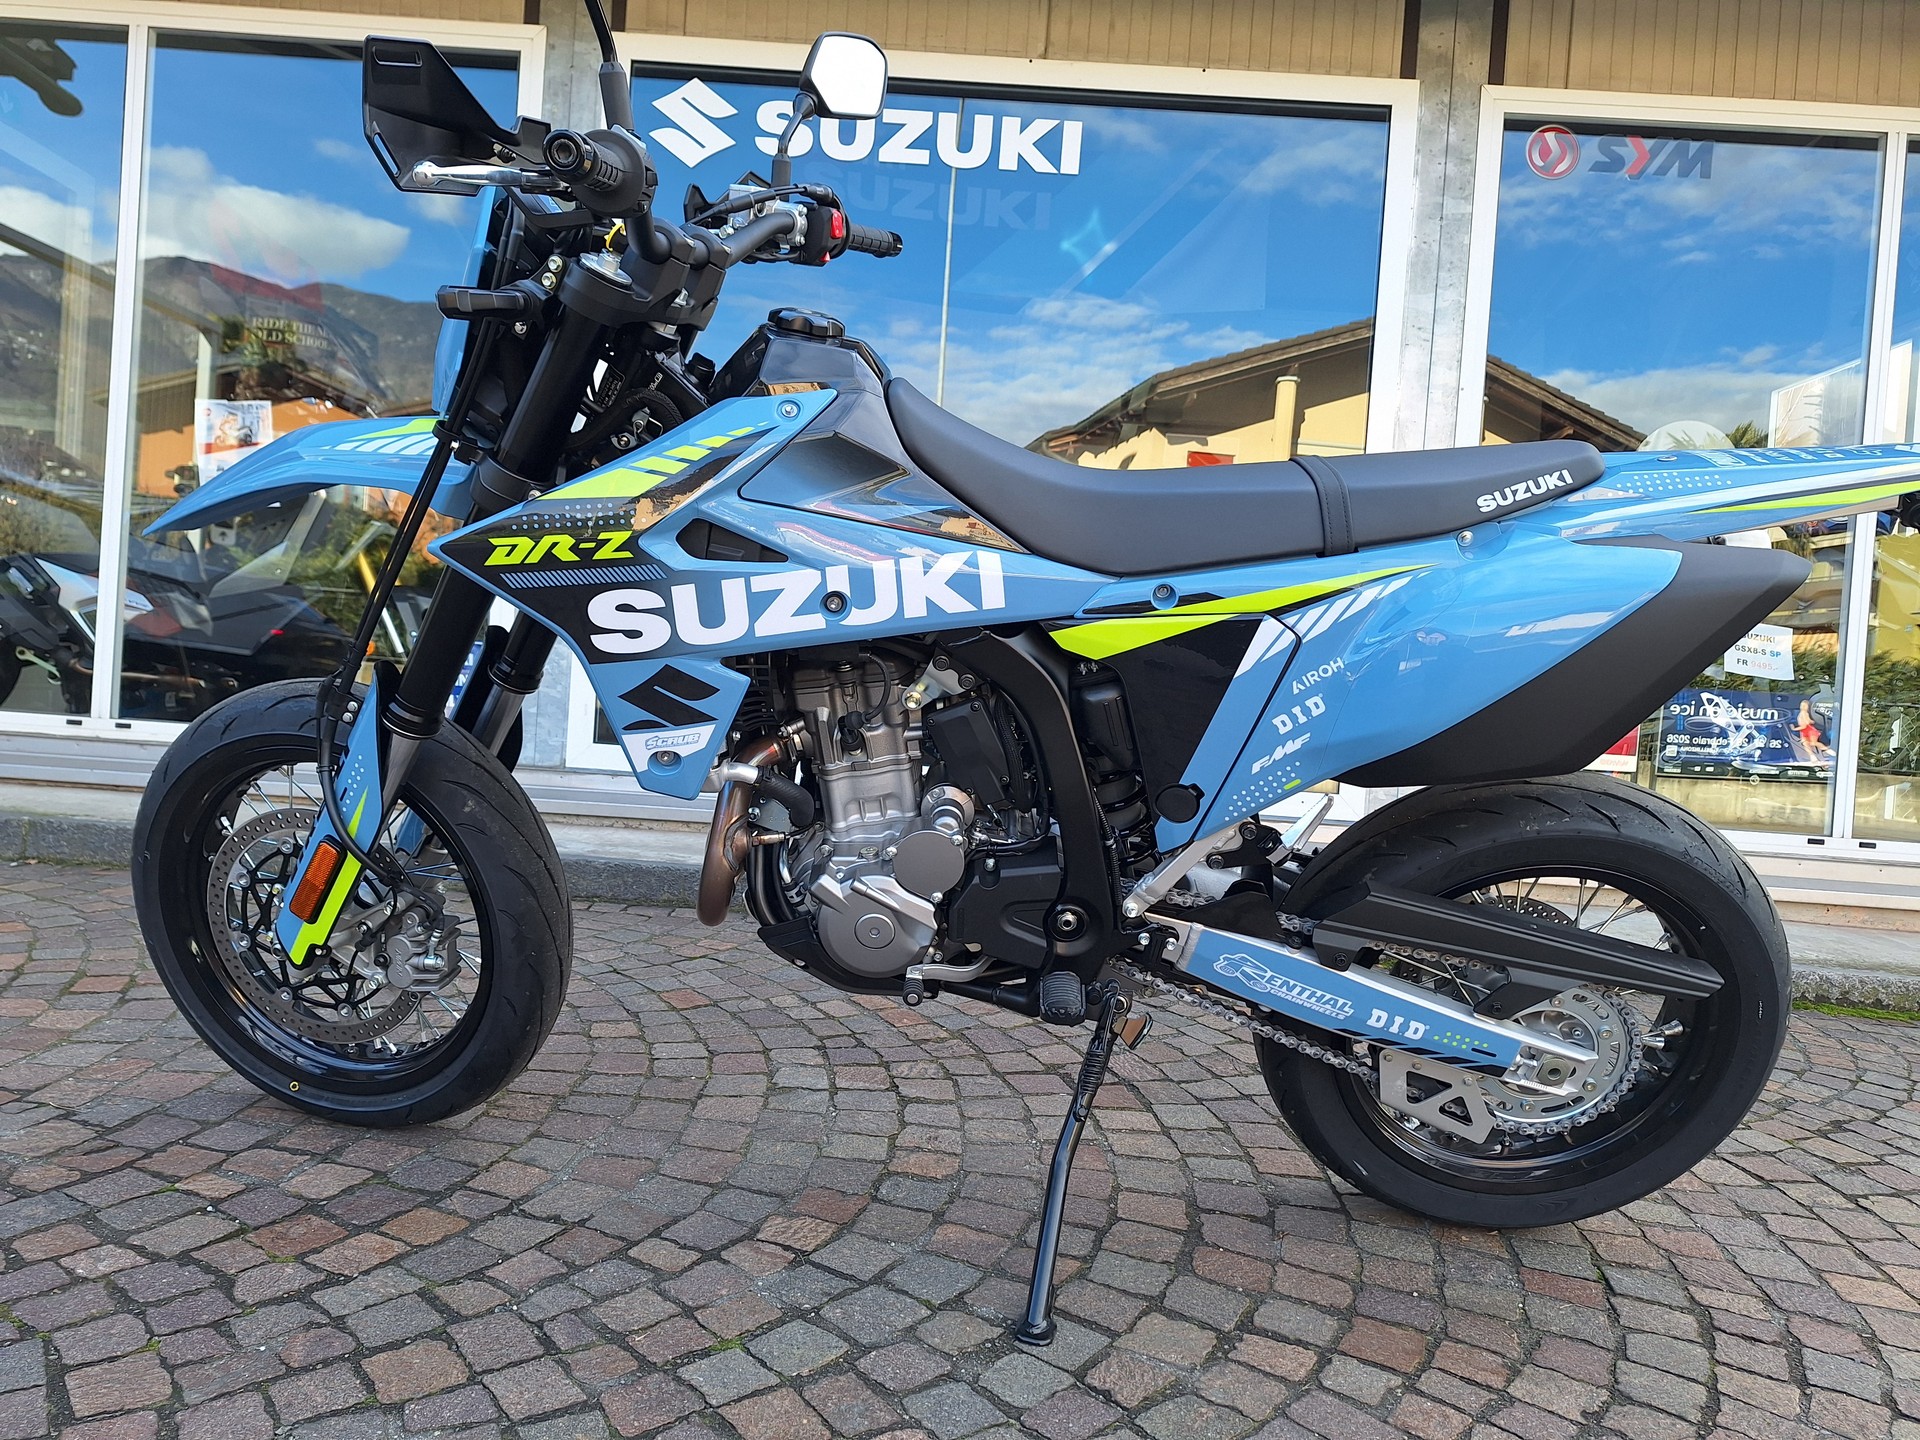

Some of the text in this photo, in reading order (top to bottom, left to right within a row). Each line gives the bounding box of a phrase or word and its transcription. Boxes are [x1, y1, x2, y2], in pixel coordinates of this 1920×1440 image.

[754, 100, 1083, 175] SUZUKI
[1588, 134, 1715, 180] SYM
[1476, 469, 1574, 513] SUZUKI
[484, 530, 635, 566] DR-Z
[587, 550, 1006, 654] SUZUKI
[1734, 644, 1782, 658] GSX8-S SP
[1743, 633, 1776, 643] UZUKI
[1291, 657, 1345, 695] AIROH
[1736, 658, 1749, 666] FR
[1251, 732, 1311, 775] FMF
[1269, 988, 1346, 1020] CHAINWHEELS
